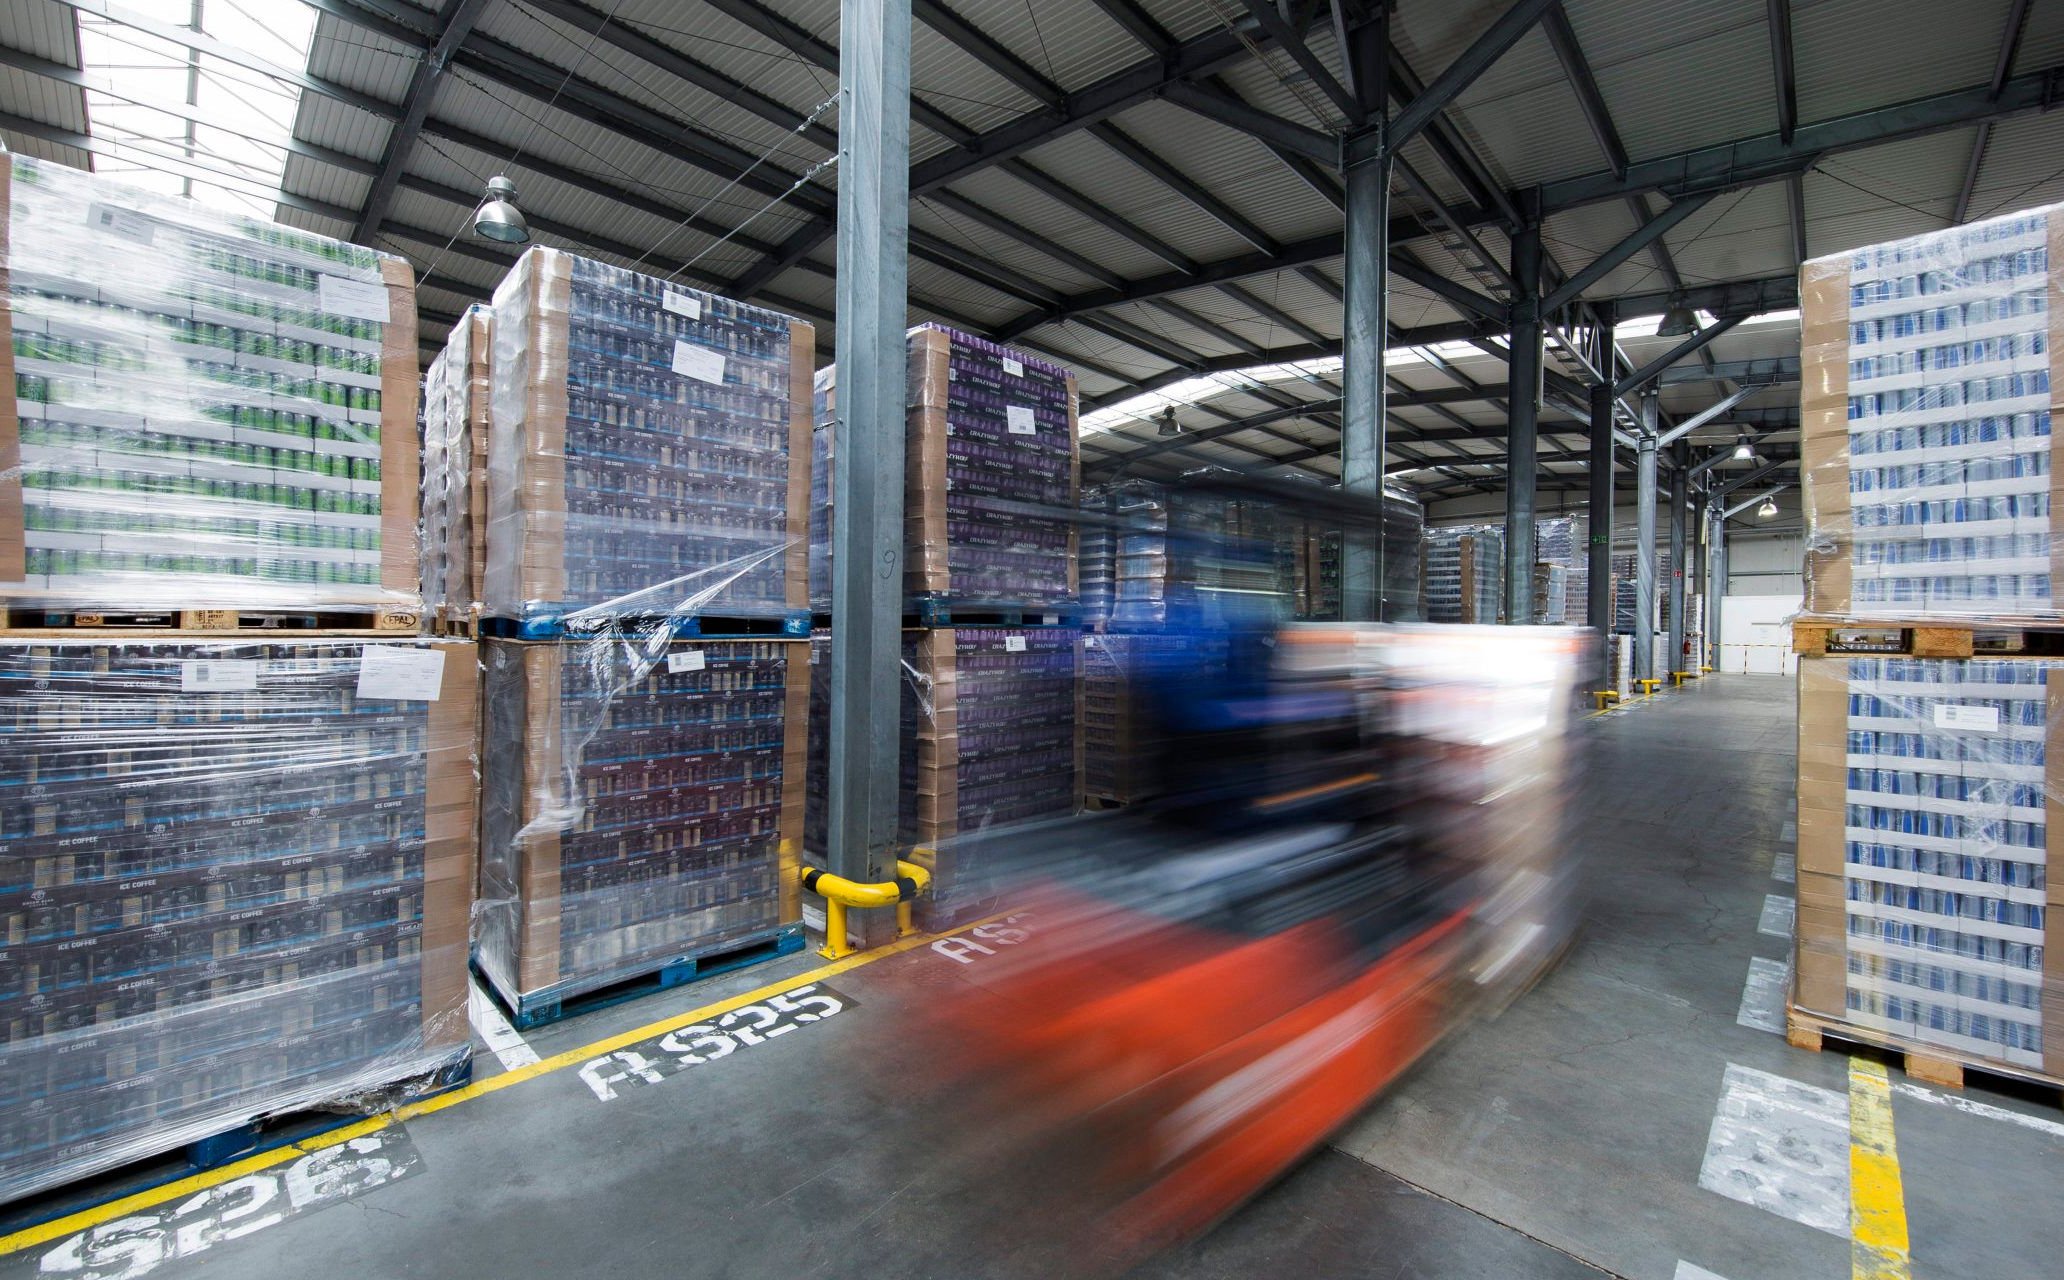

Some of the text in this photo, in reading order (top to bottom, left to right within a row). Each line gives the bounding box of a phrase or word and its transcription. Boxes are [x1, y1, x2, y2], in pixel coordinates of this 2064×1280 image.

[242, 818, 264, 826] COFFEE
[72, 836, 98, 845] COFFEE
[292, 857, 312, 865] COFFEE
[132, 880, 156, 889] COFFEE
[241, 910, 263, 919] COFFEE
[58, 939, 97, 951] ICE COFFEE
[290, 947, 310, 955] COFFEE
[118, 978, 155, 991] ICE COFFEE
[58, 1039, 97, 1053] ICE COFFEE
[578, 985, 843, 1101] AS25
